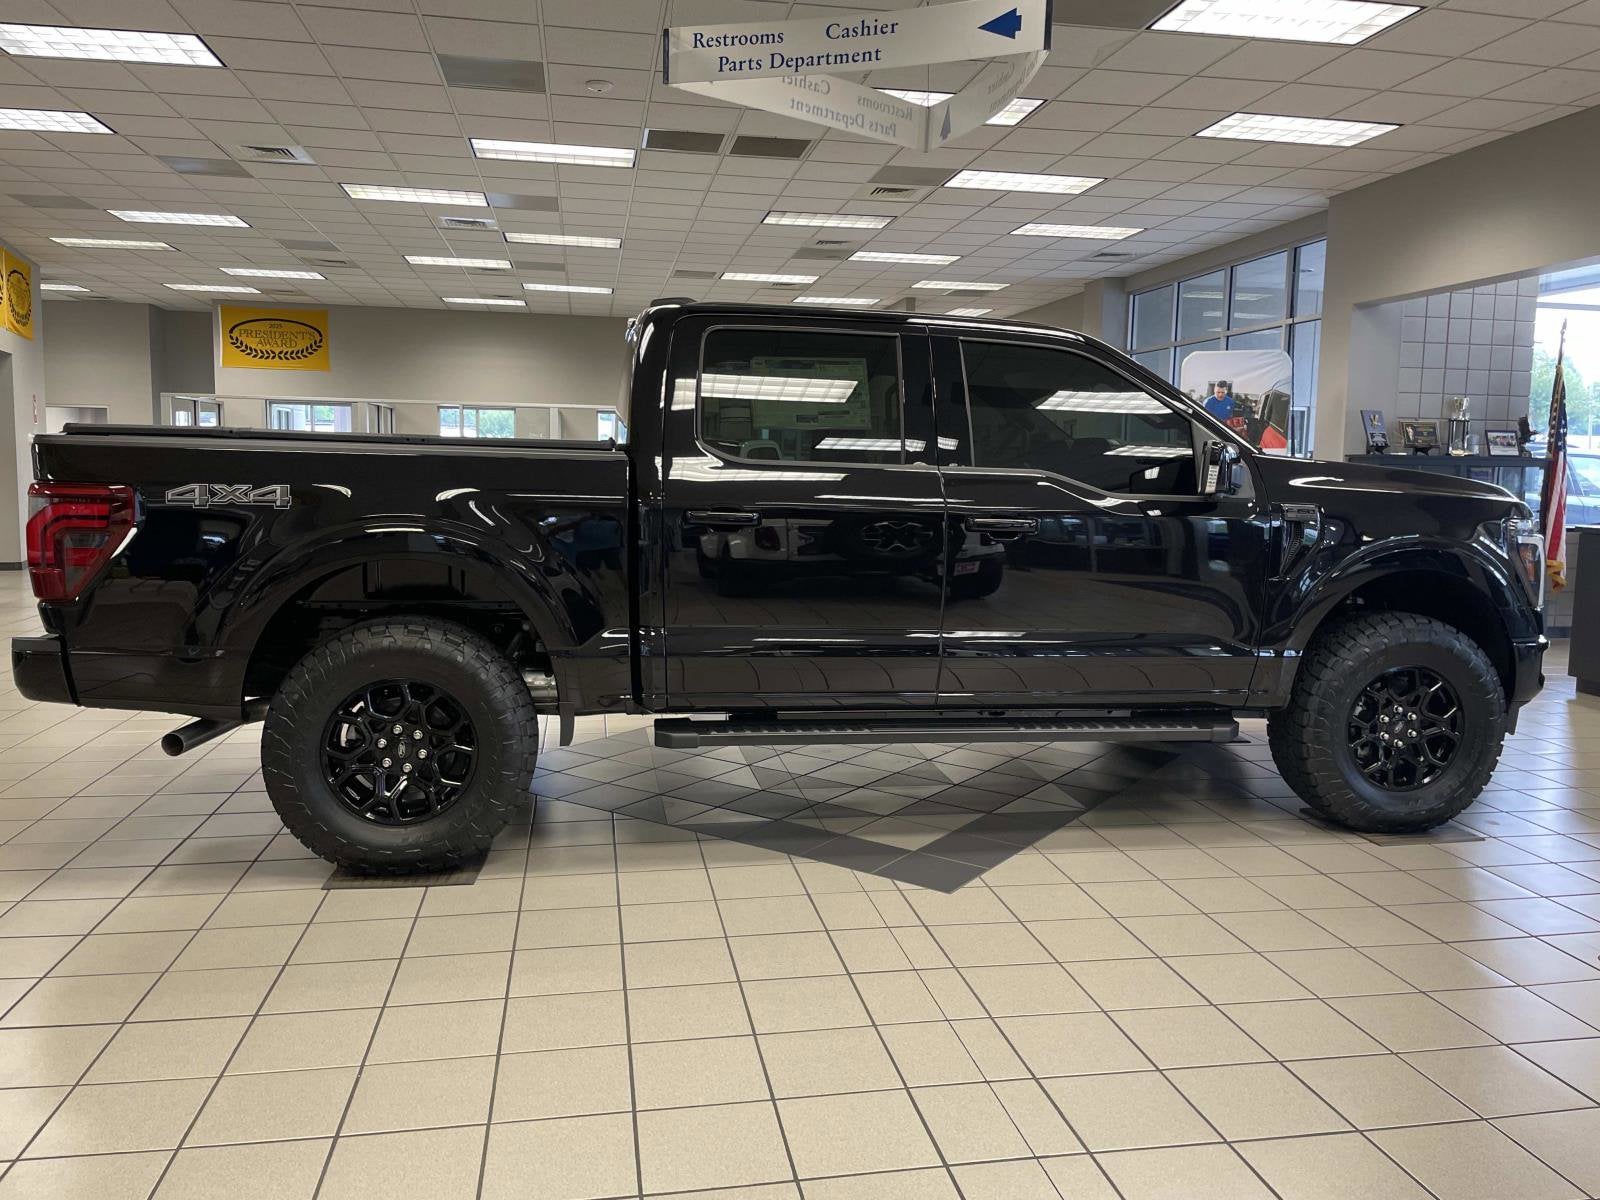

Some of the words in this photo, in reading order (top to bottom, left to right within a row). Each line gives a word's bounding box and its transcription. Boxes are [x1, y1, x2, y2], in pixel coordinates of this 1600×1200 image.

[693, 31, 785, 49] Restrooms
[825, 20, 899, 40] Cashier
[718, 55, 763, 73] Parts
[769, 48, 882, 73] Department
[240, 328, 316, 340] PRESIDENT'S
[256, 339, 298, 348] AWARD
